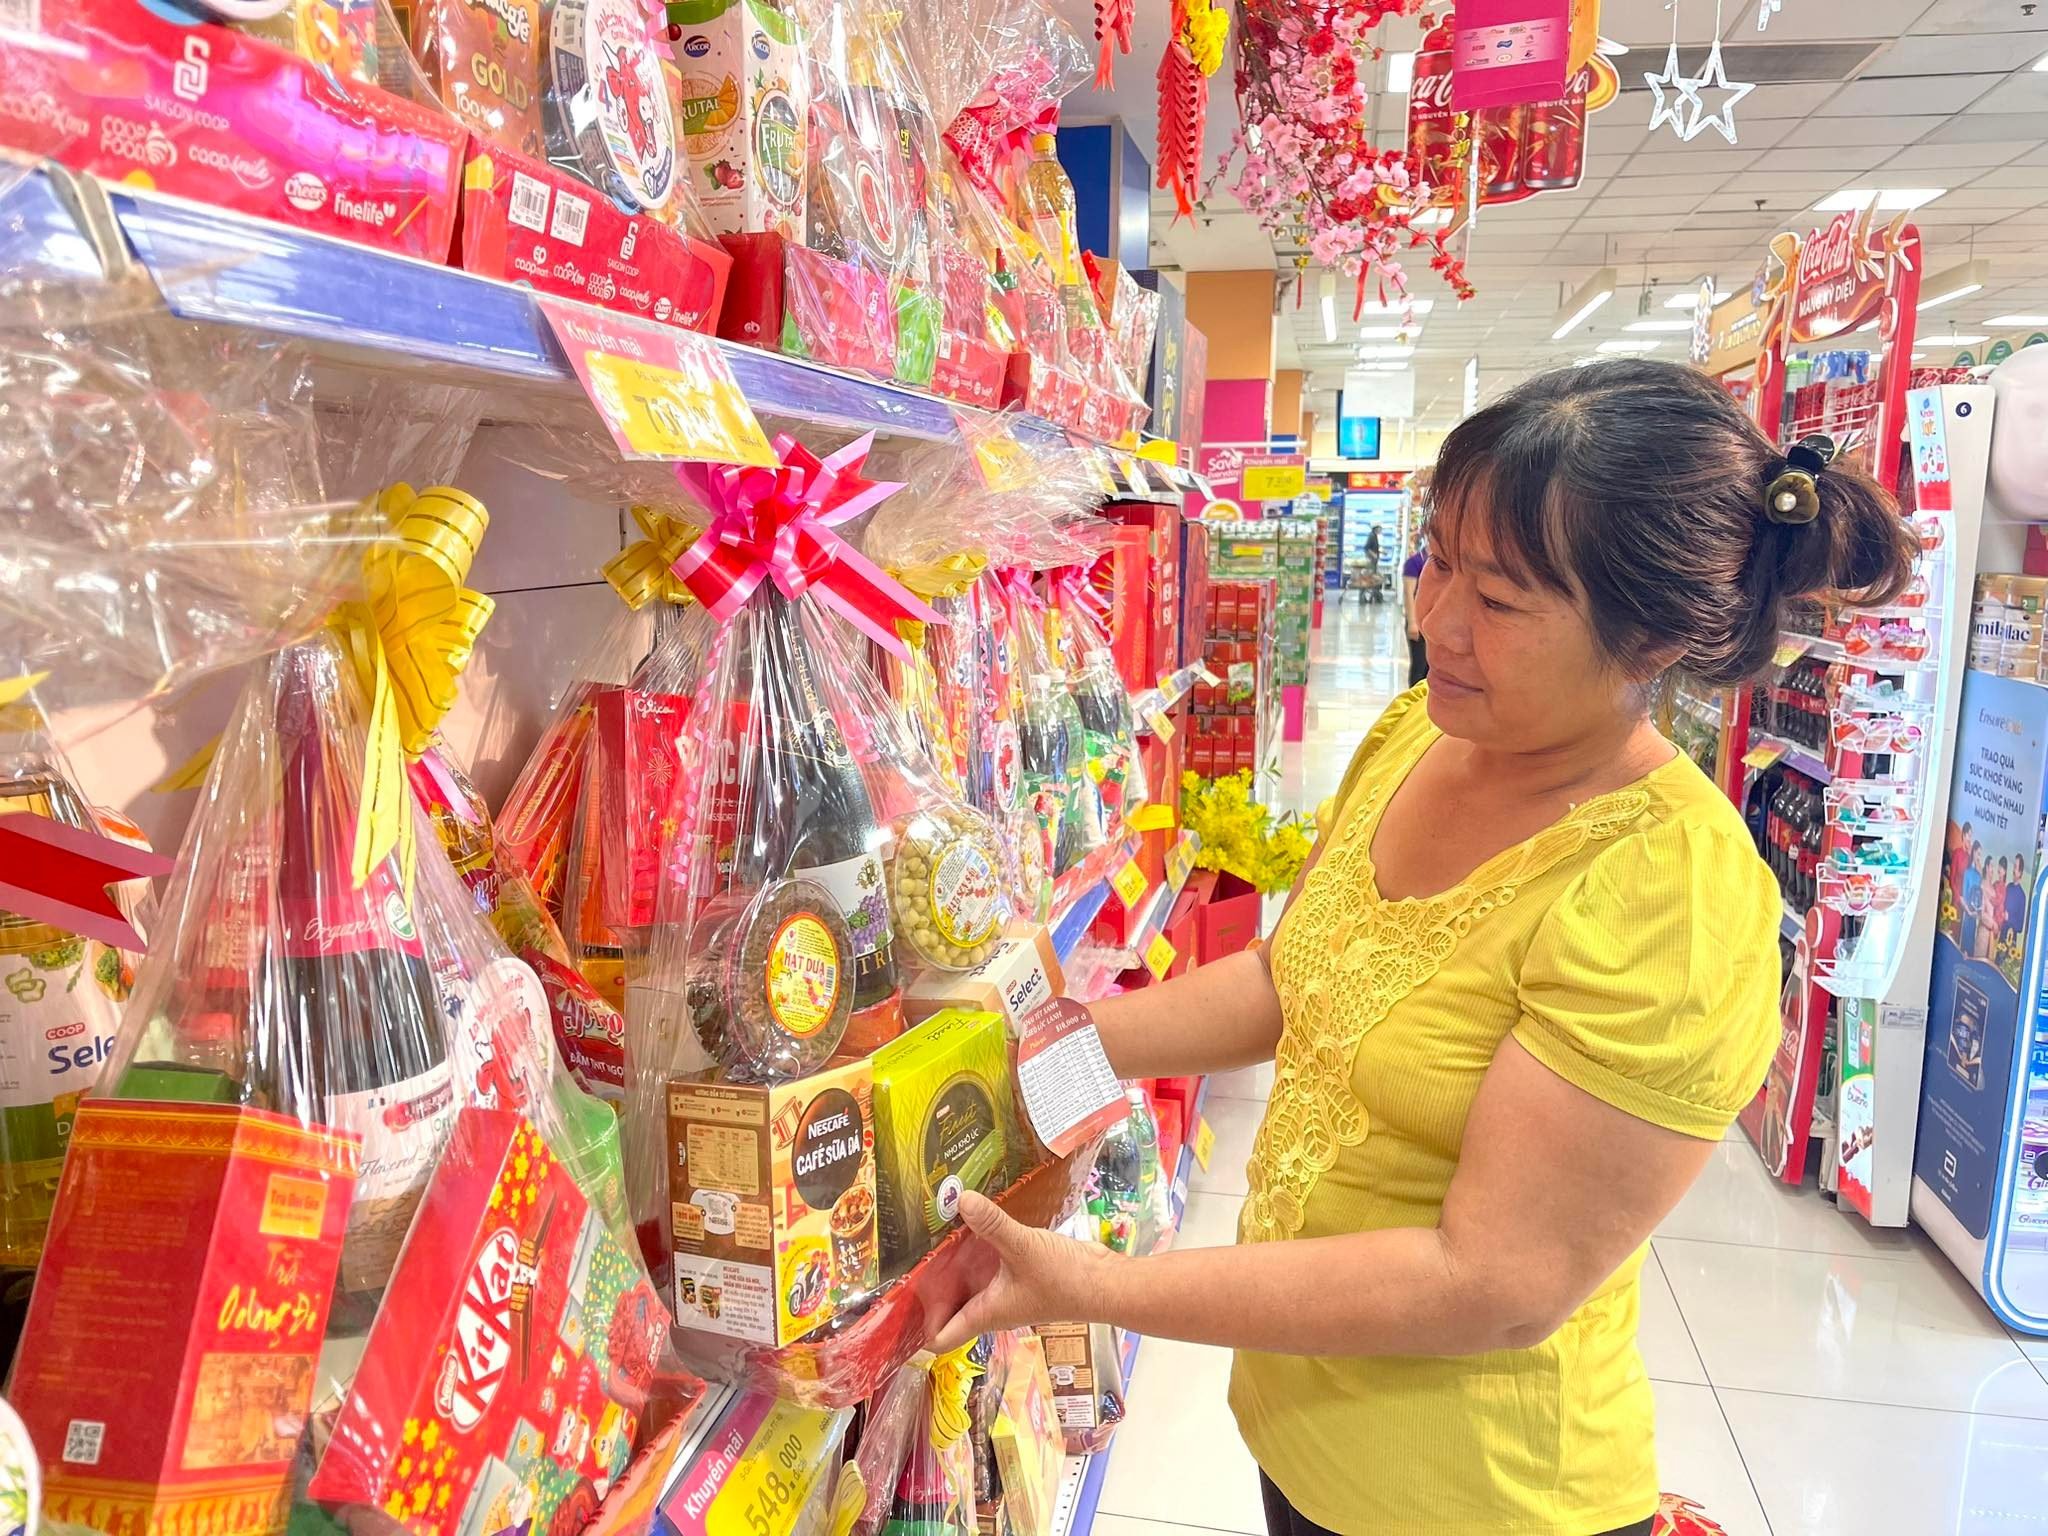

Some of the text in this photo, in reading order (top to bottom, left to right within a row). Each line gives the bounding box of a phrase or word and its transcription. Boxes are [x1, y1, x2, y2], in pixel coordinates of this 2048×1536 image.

[472, 52, 528, 110] GOLD
[335, 193, 385, 227] finelife
[1961, 404, 1968, 415] 6
[1009, 968, 1042, 1012] Select
[47, 1023, 85, 1040] COOP
[808, 1107, 850, 1139] NESCAFÉ
[796, 1143, 826, 1176] CAFÉ
[826, 1138, 847, 1165] SỮA
[684, 1428, 745, 1520] Khuyến mãi
